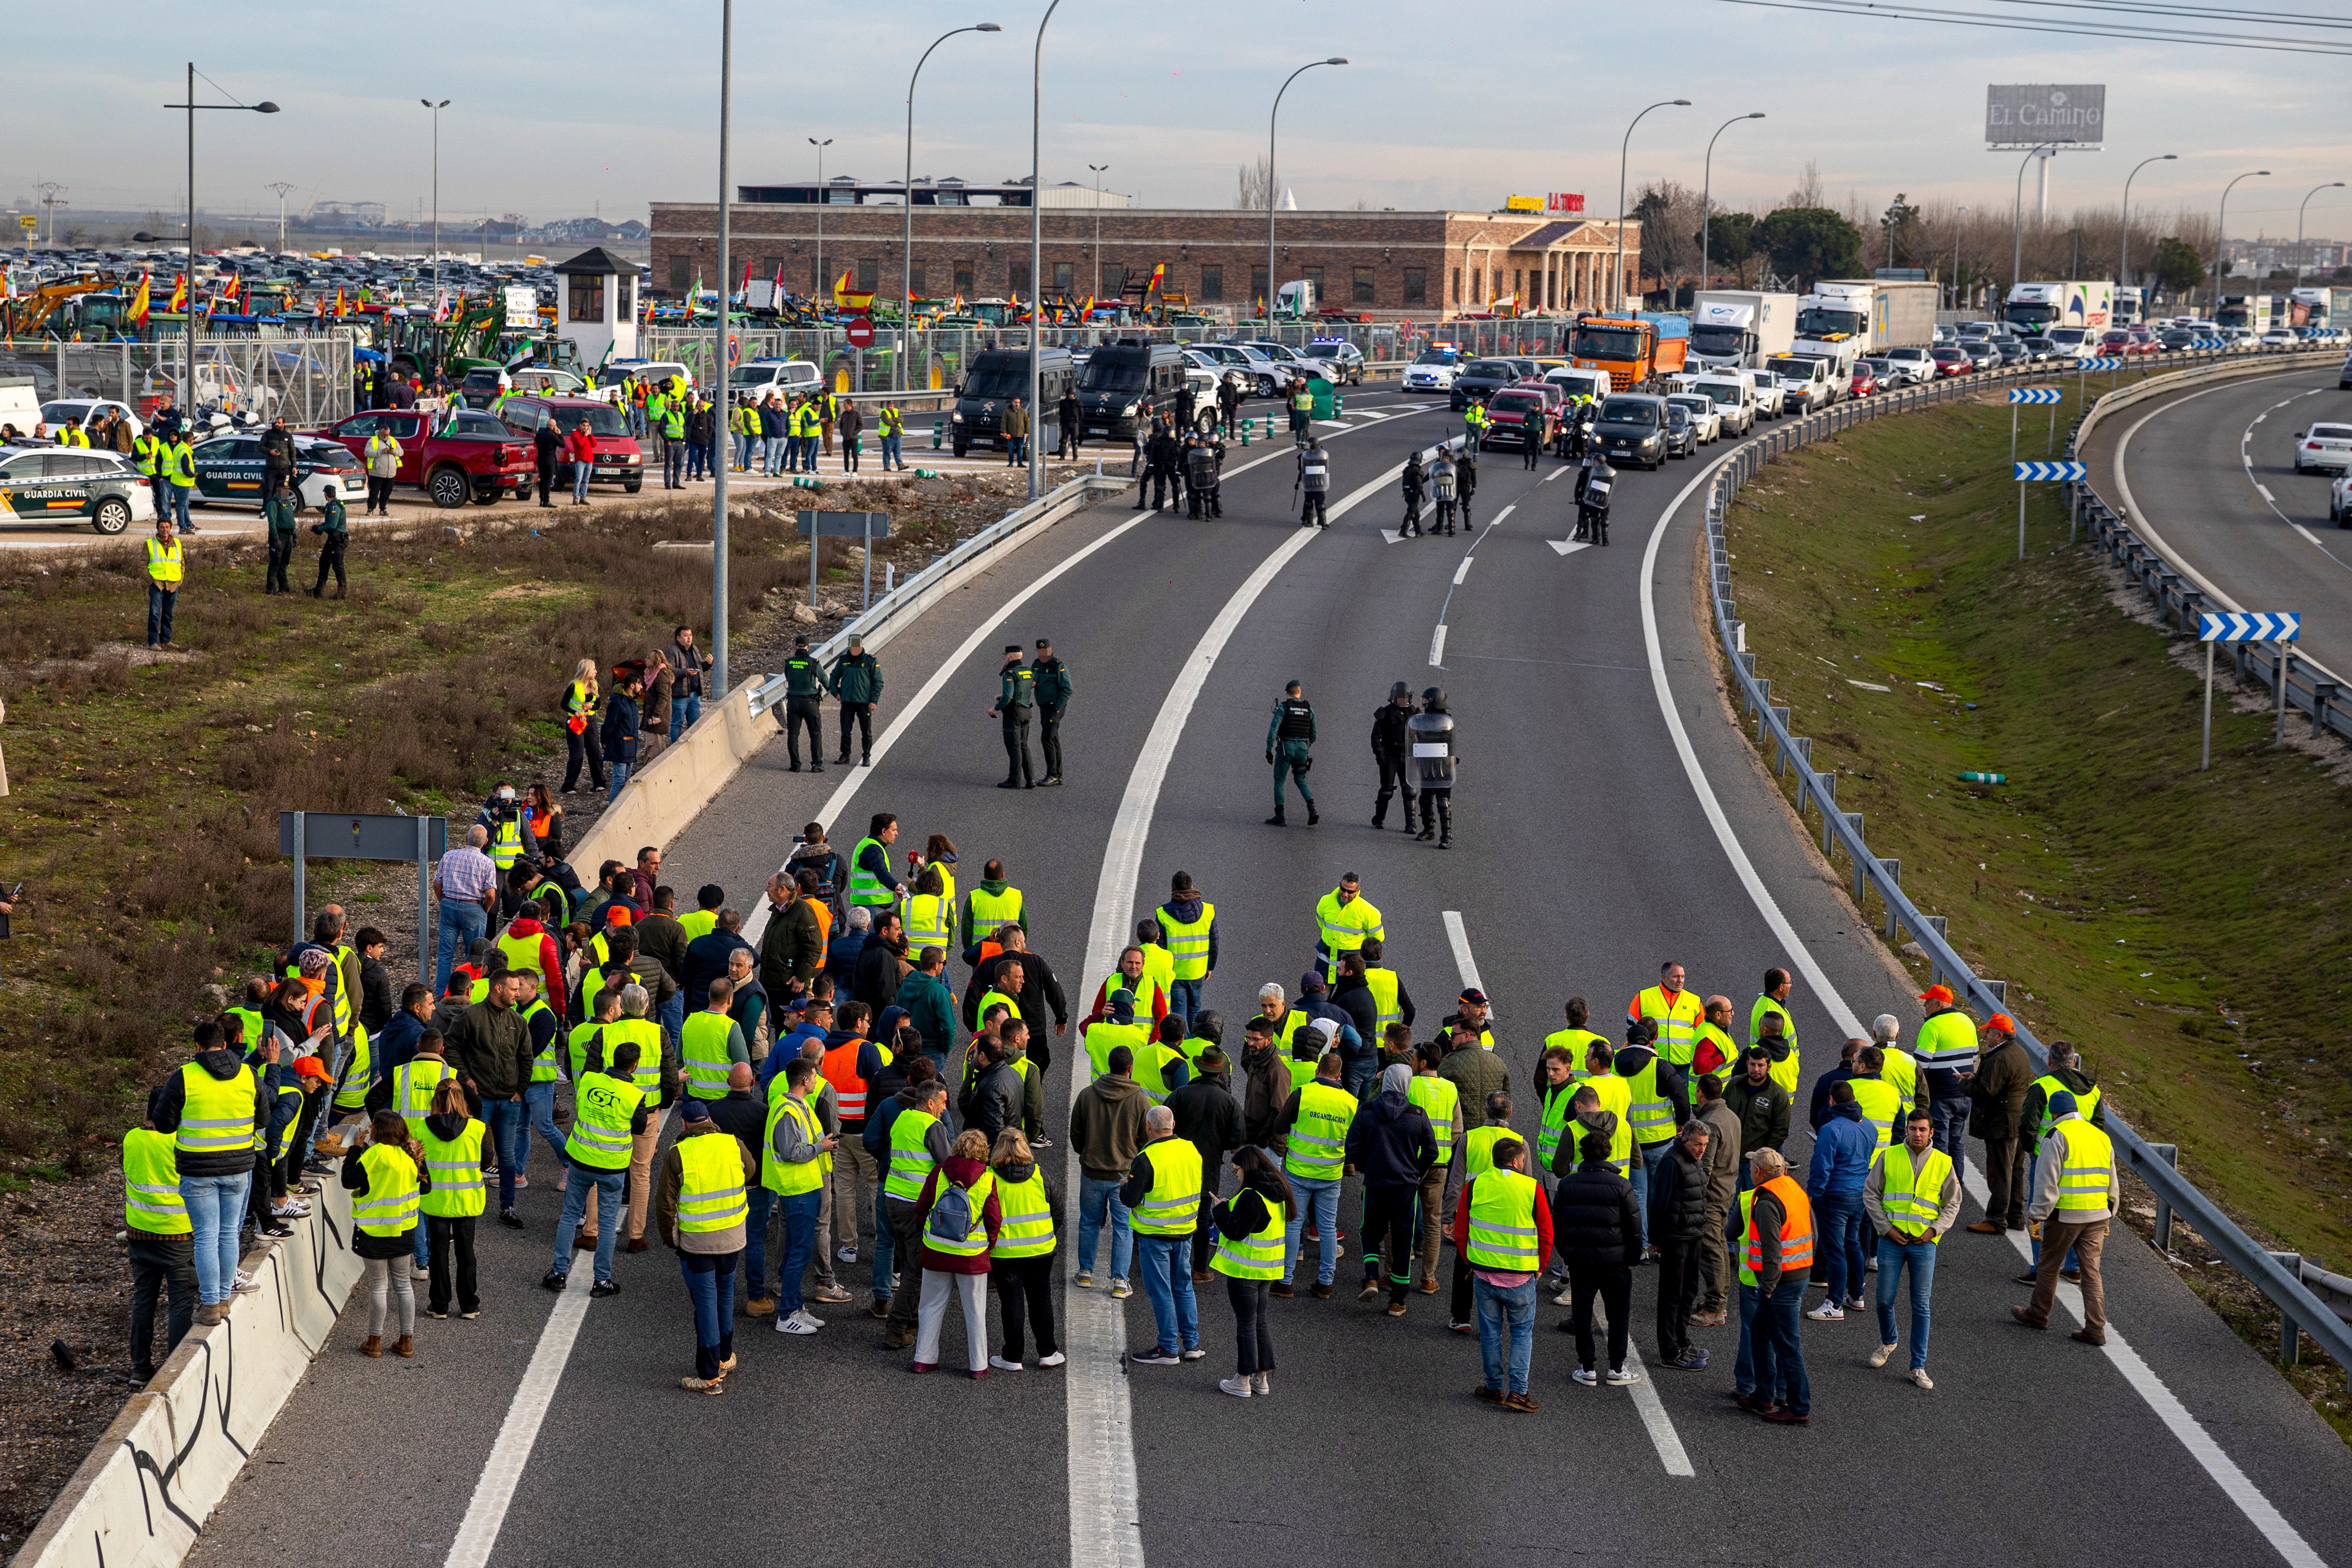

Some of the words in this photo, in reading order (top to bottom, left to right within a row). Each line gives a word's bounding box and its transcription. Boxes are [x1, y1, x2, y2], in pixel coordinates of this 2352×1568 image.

[1549, 192, 1559, 210] LA
[1561, 193, 1585, 212] TORRE
[24, 490, 63, 499] GUARDIA
[65, 489, 87, 497] CIVIL
[1310, 1111, 1346, 1124] ORGANIZACION
